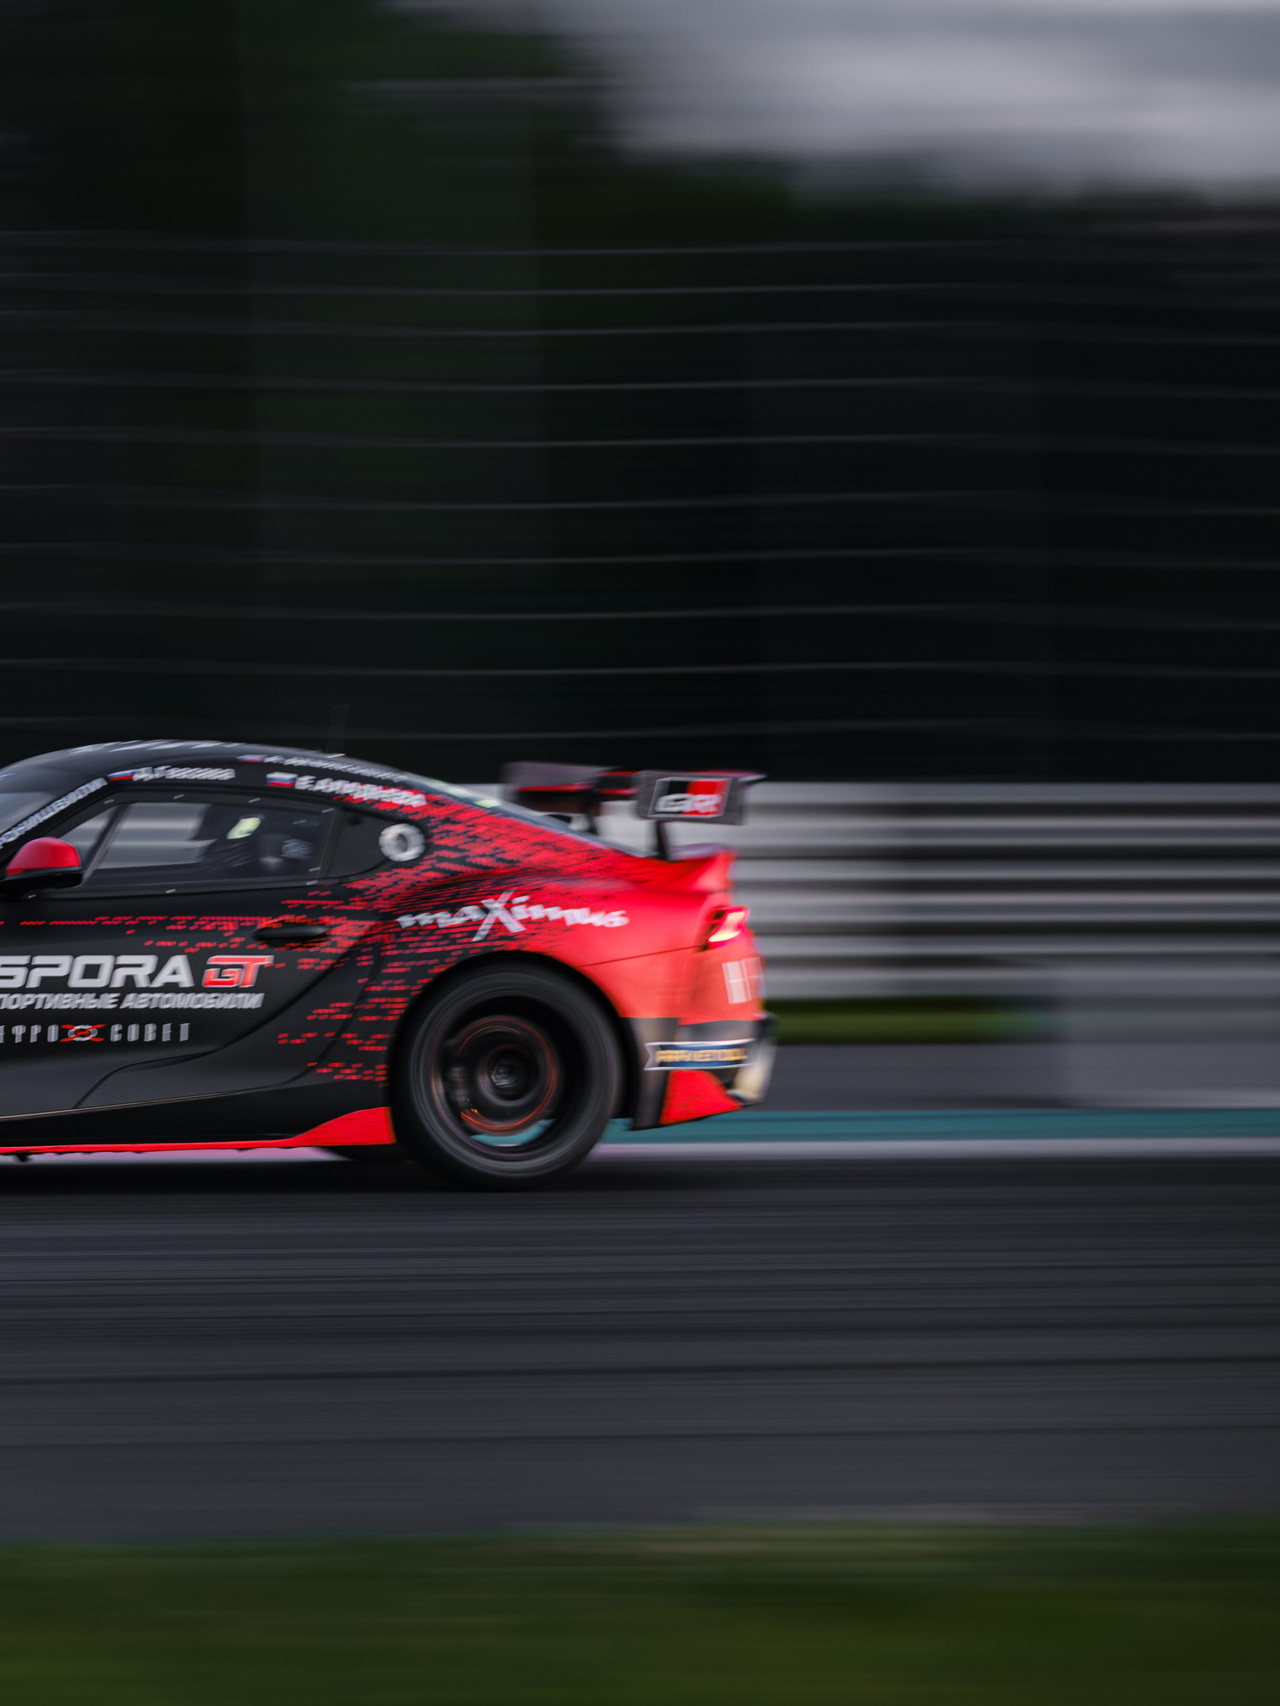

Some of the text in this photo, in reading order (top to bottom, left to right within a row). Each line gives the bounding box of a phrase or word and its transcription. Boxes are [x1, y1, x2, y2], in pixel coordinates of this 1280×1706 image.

[655, 793, 722, 813] GR
[202, 954, 274, 988] GT
[120, 992, 265, 1010] АВТОМОБИЛИ
